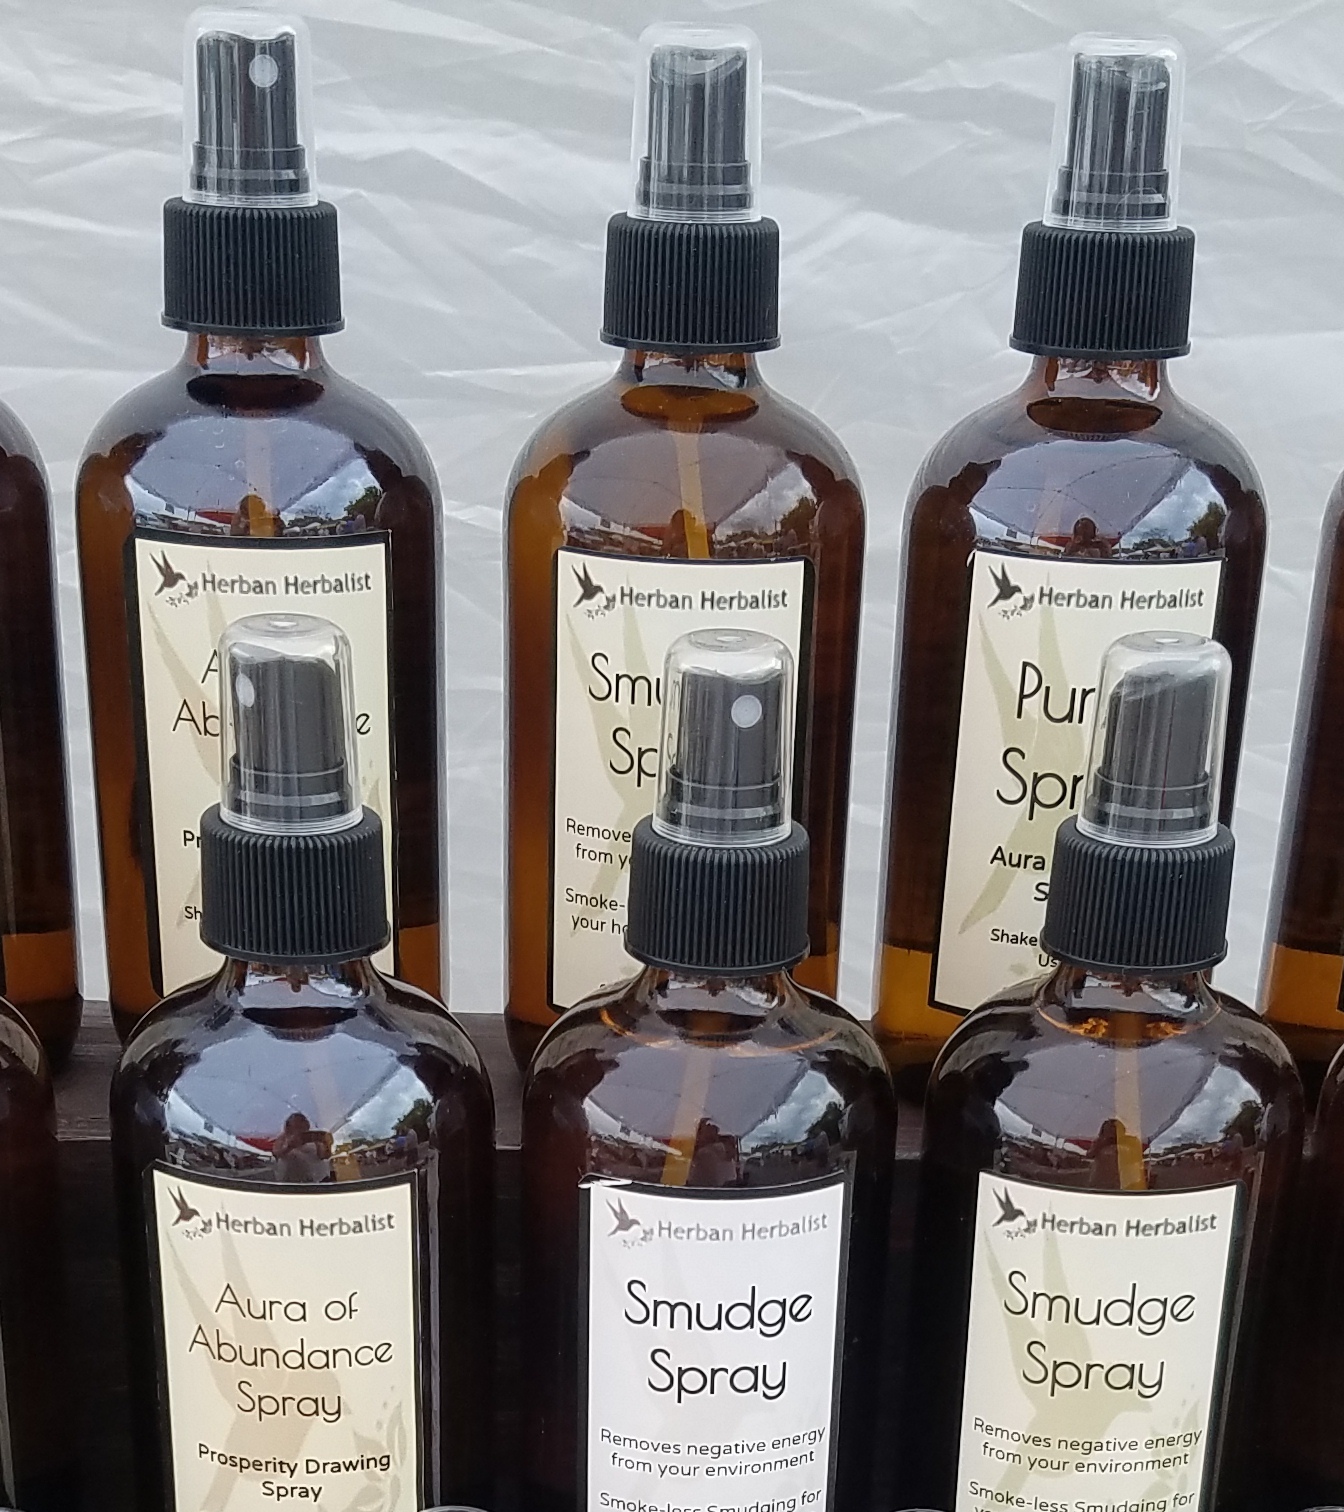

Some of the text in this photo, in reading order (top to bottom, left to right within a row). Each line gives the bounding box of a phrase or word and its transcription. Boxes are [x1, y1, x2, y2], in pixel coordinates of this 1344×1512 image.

[201, 572, 372, 595] Herban Herbalist
[619, 586, 787, 611] Herban Herbalist
[1039, 586, 1204, 610] Herban Herbalist
[989, 846, 1045, 871] Aura
[571, 914, 605, 935] your
[990, 928, 1038, 947] Shake
[216, 1212, 395, 1237] Herban Herbalist
[658, 1214, 827, 1242] Herban Herbalist
[1041, 1212, 1216, 1238] Herban Herbalist
[215, 1283, 359, 1322] Aura of
[624, 1280, 812, 1338] Smudge
[1004, 1270, 1195, 1336] Smudge
[189, 1323, 393, 1370] Abundance
[647, 1348, 786, 1403] Spray
[1022, 1340, 1164, 1398] Spray
[236, 1380, 343, 1422] Spray
[600, 1426, 826, 1459] Removes negative energy
[198, 1443, 391, 1478] Prosperity Drawing
[611, 1450, 815, 1478] from your environment
[800, 1488, 821, 1505] for
